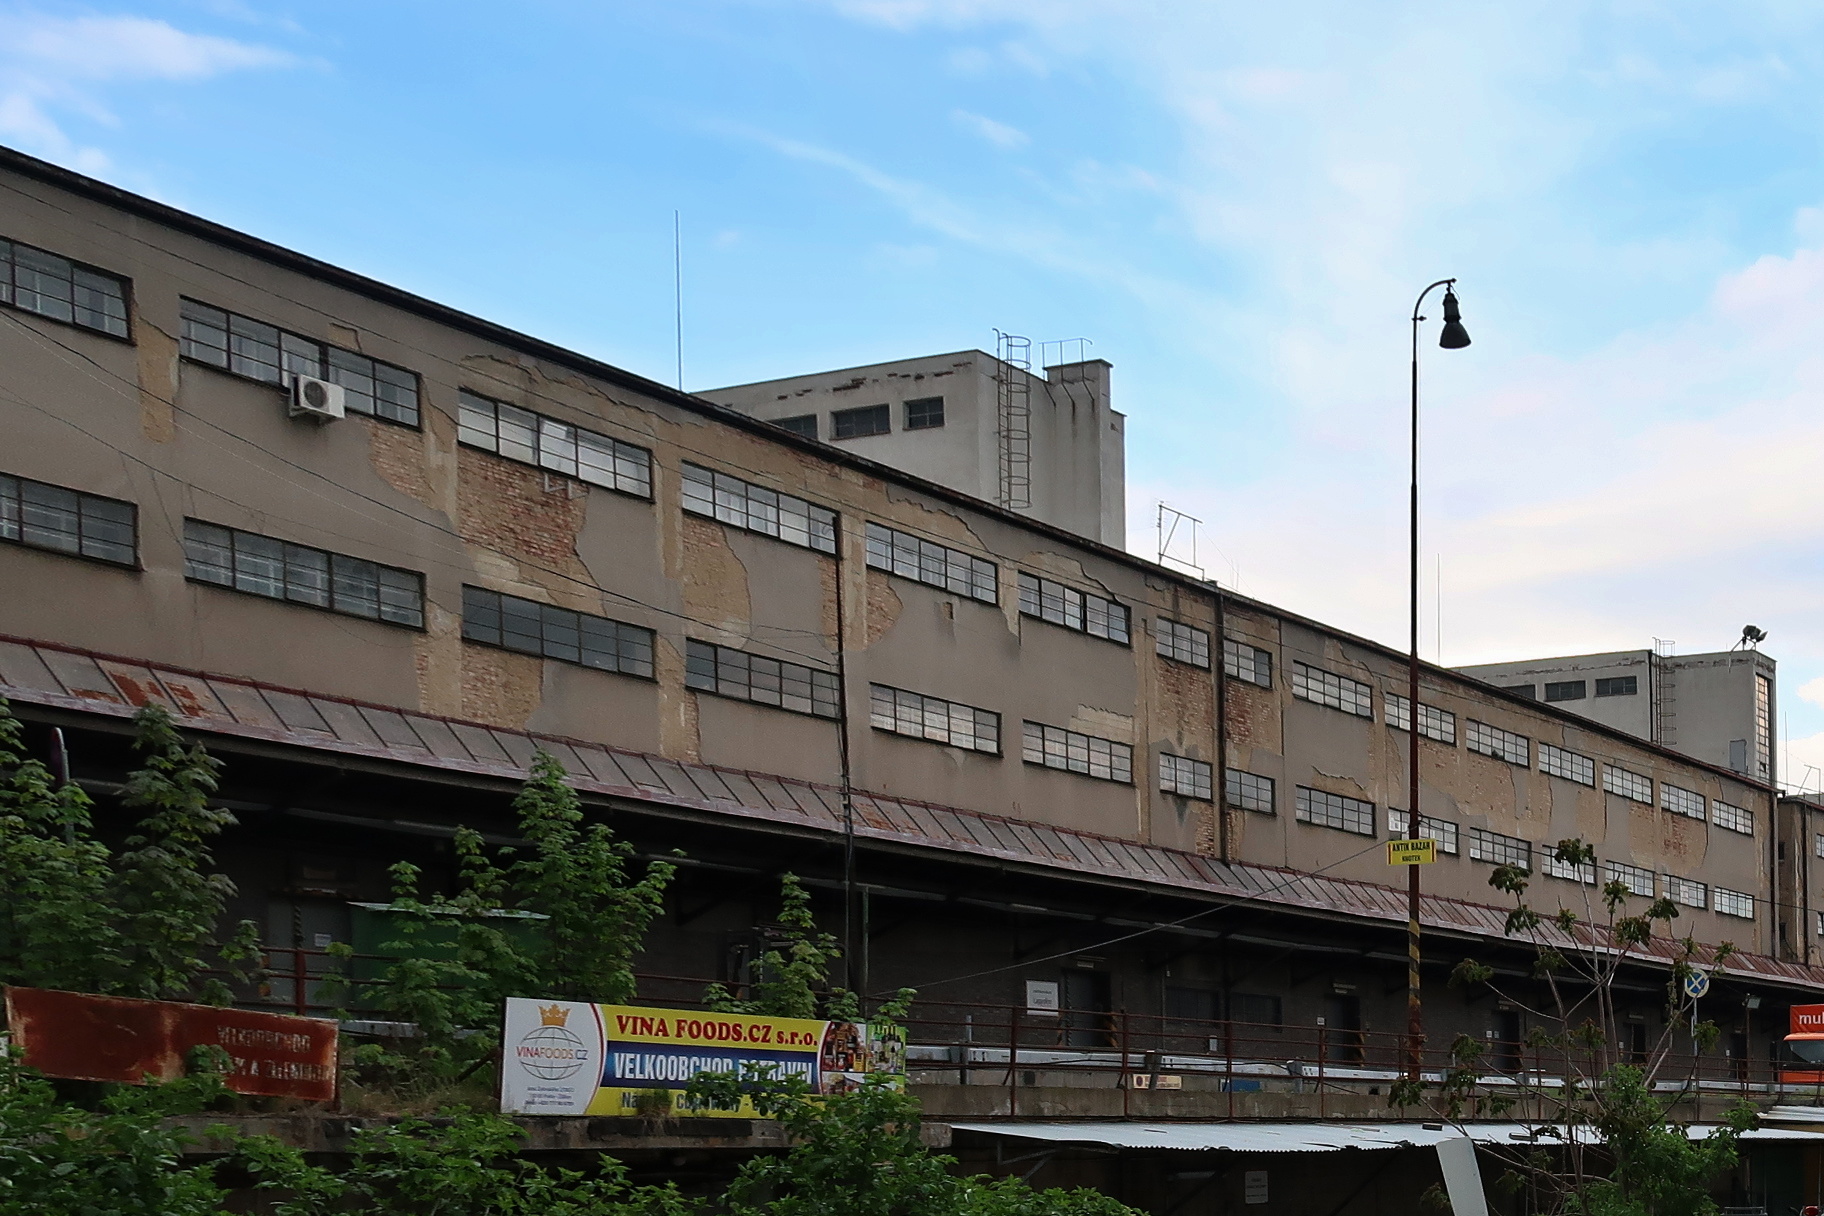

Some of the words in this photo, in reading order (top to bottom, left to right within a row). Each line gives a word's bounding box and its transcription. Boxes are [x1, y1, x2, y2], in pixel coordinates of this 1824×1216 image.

[616, 1015, 669, 1037] VINA
[675, 1019, 772, 1043] FOODS.CZ
[777, 1030, 818, 1046] s.r.o.
[614, 1052, 733, 1082] VELKOOBCHOD
